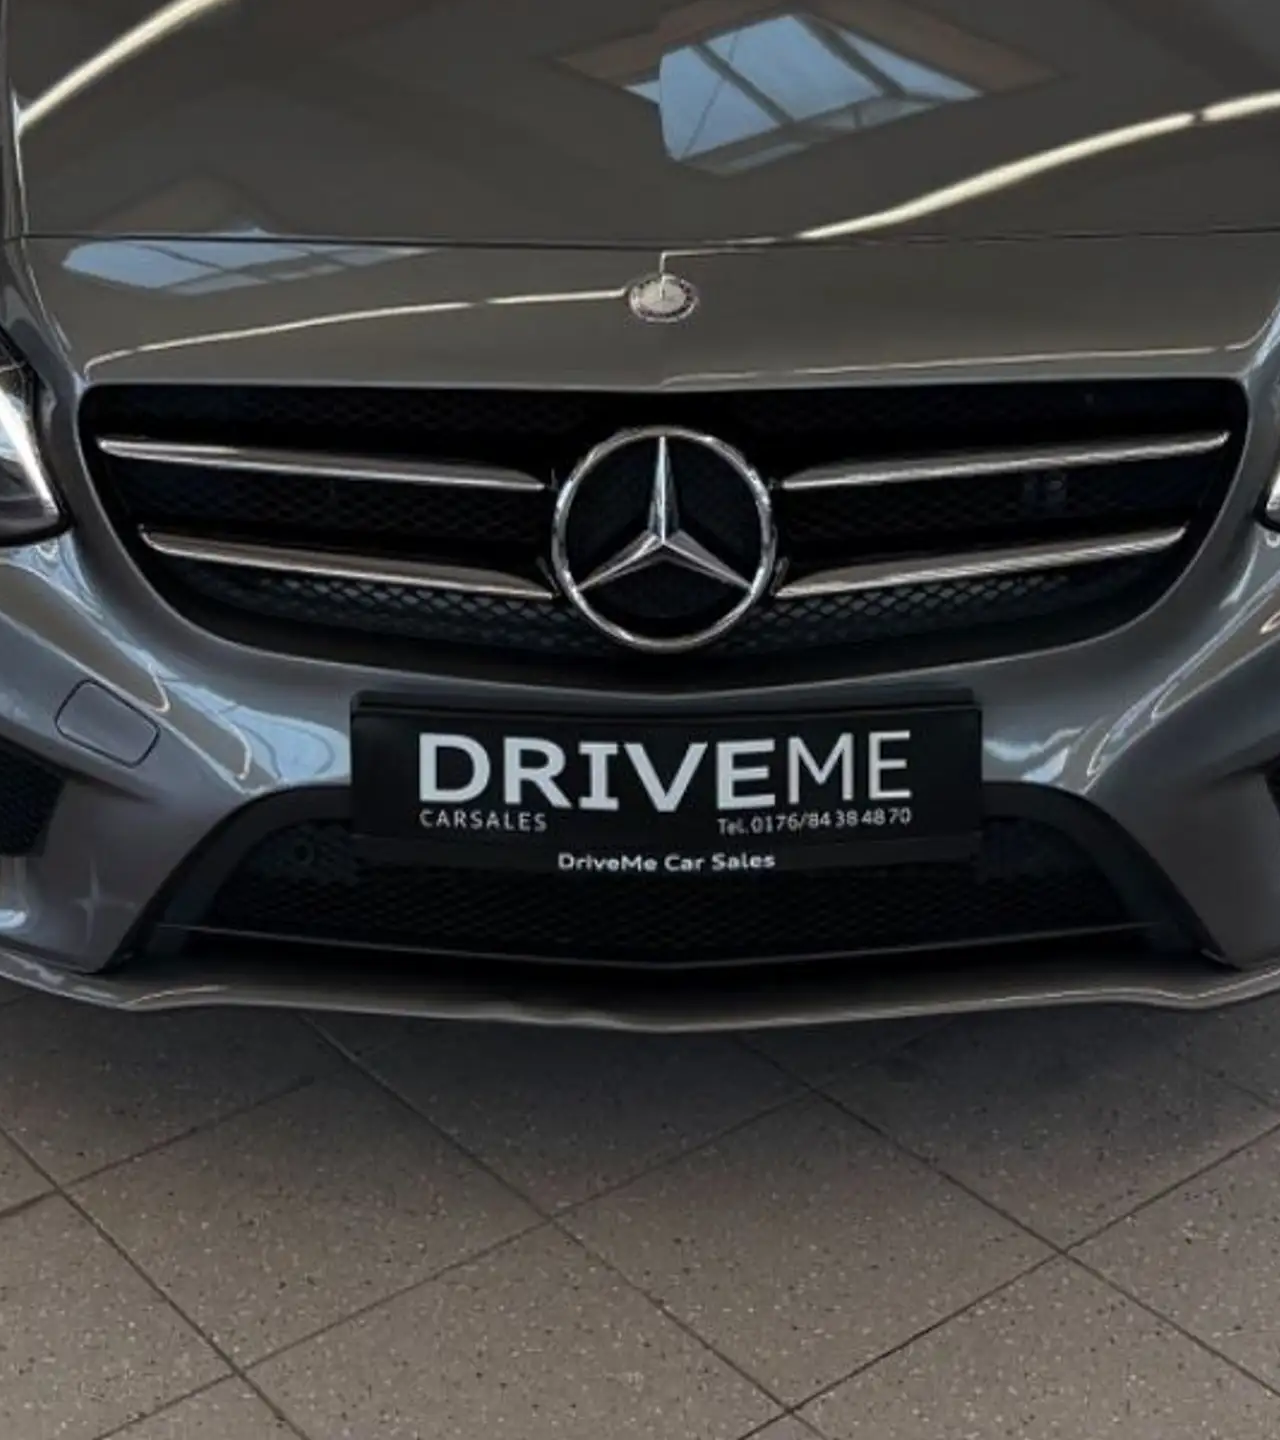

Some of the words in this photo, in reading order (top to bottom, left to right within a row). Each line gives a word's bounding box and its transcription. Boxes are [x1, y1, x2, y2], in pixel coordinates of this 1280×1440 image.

[418, 729, 912, 813] DRIVEME
[418, 809, 548, 832] CARSALES
[557, 852, 658, 872] DriveMe
[664, 854, 705, 872] Car
[711, 851, 776, 872] Sales
